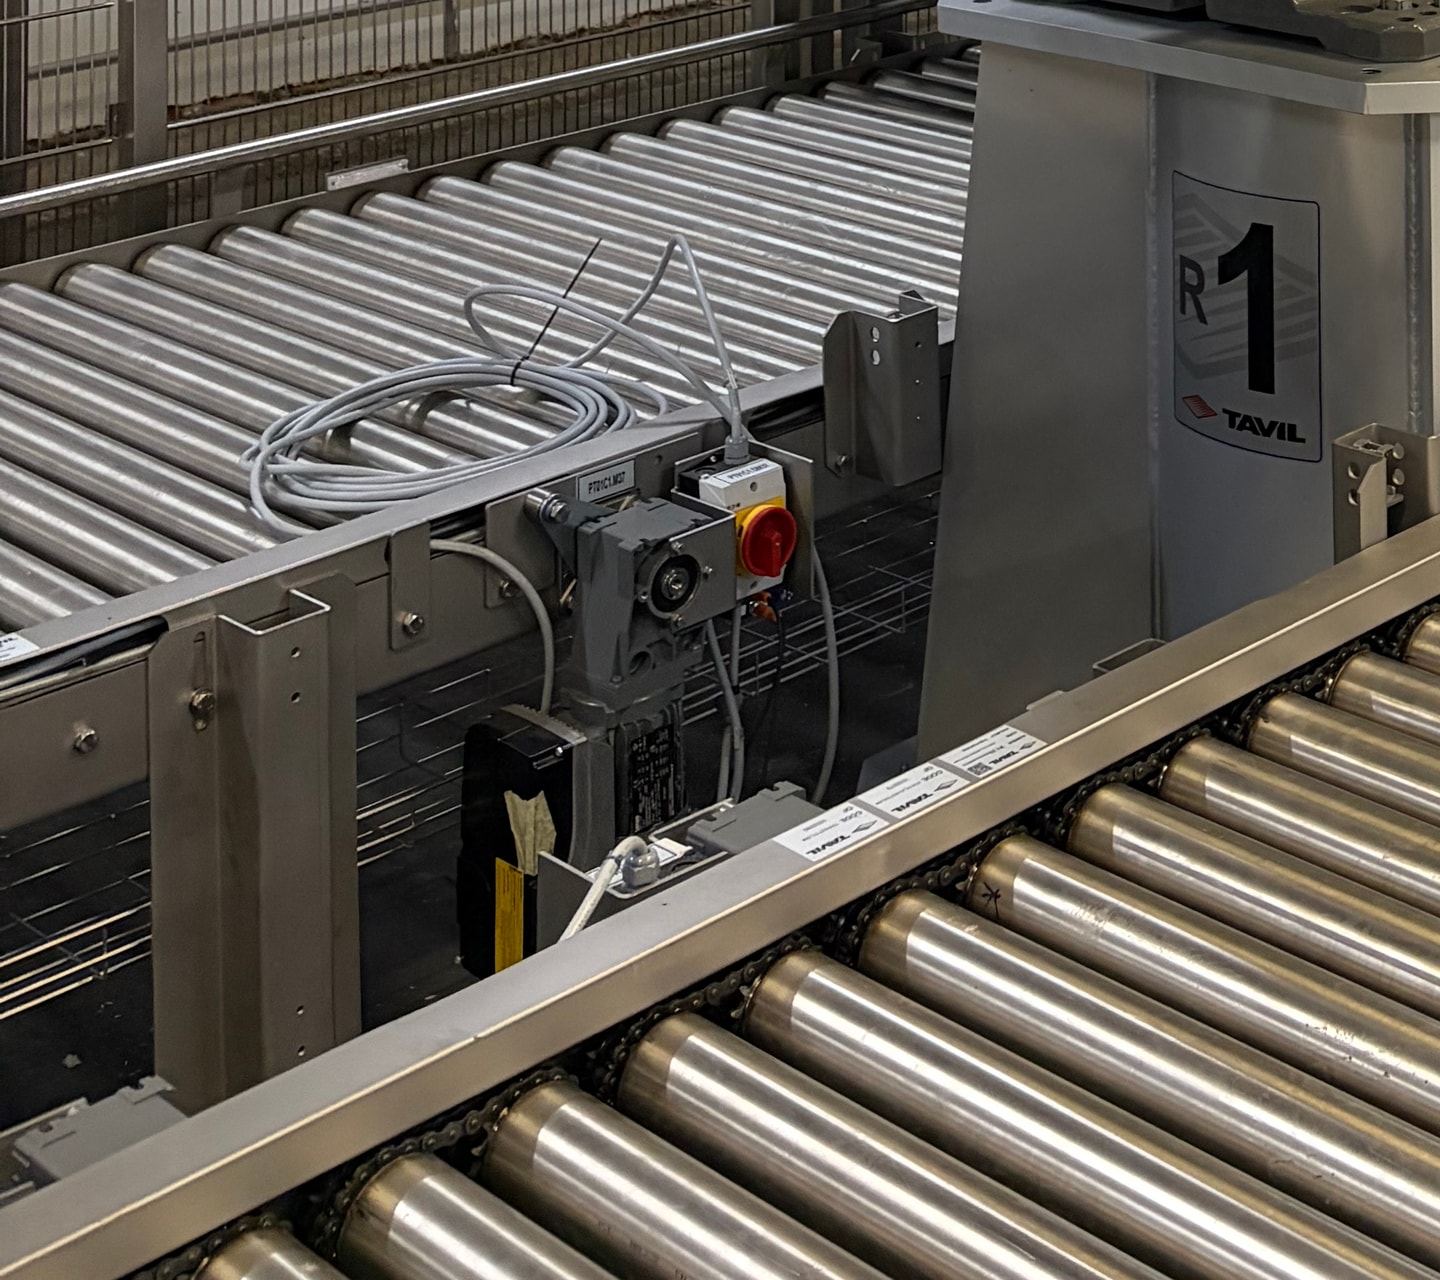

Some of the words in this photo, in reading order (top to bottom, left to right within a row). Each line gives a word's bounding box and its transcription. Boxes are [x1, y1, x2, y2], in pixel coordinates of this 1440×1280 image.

[1179, 253, 1208, 326] R
[1217, 221, 1275, 395] 1
[1221, 407, 1306, 444] TAVIL
[891, 792, 934, 813] TAVIL
[805, 834, 852, 855] TAVIL
